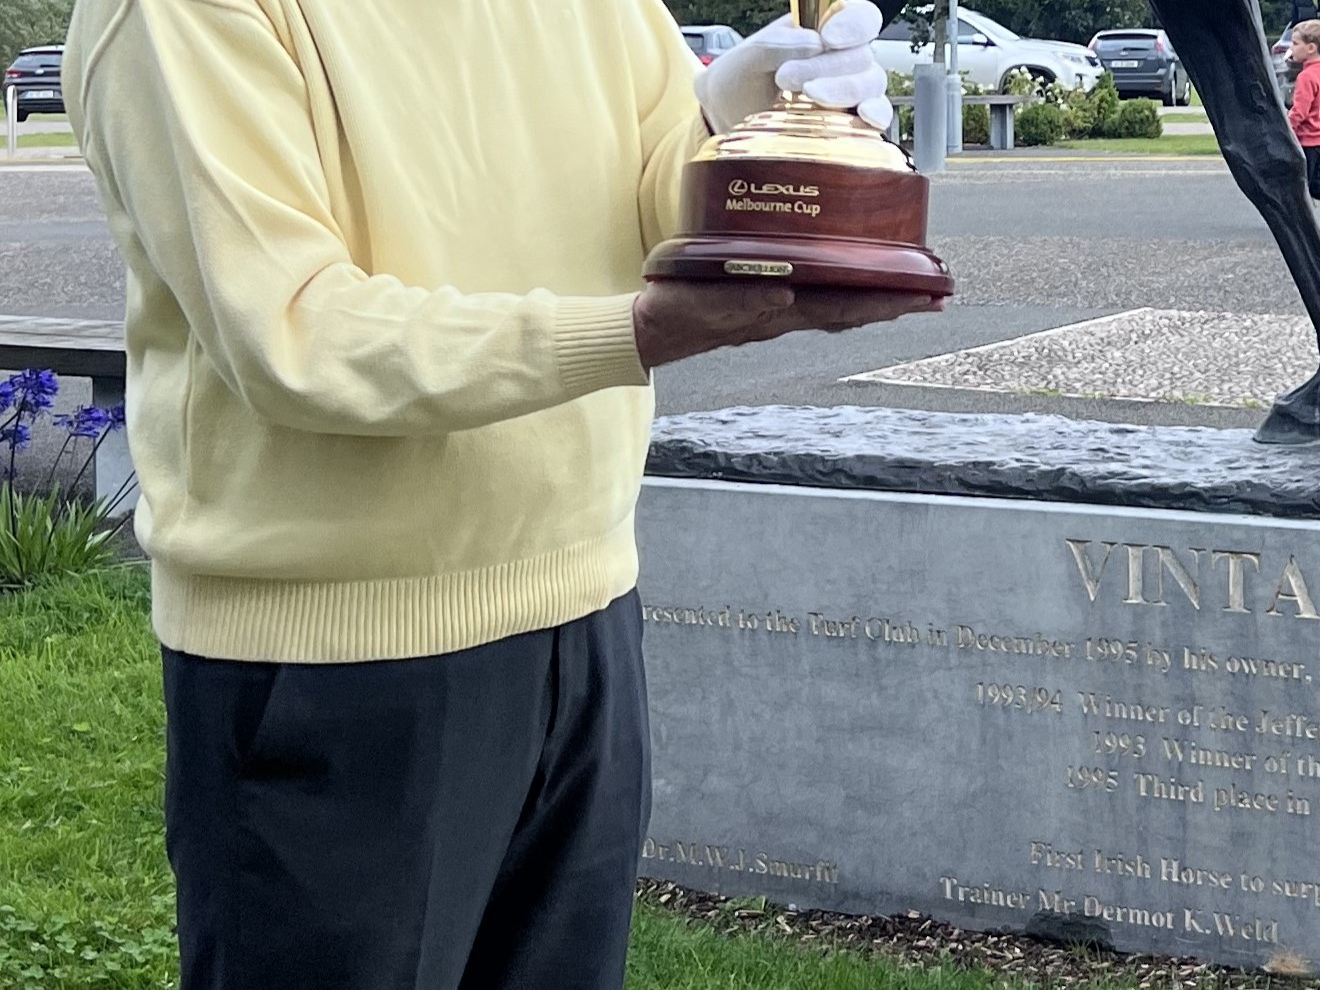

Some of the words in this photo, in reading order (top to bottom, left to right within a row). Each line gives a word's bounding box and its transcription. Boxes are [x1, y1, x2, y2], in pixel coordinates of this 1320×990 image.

[725, 197, 792, 212] Melbourne
[794, 200, 821, 218] Cup
[750, 183, 820, 196] LEXUS
[641, 604, 731, 628] resented
[738, 609, 759, 630] to
[766, 609, 800, 634] the
[807, 611, 859, 639] Turf
[864, 616, 920, 645] Club
[927, 622, 947, 647] in
[955, 624, 1075, 659] December
[1085, 636, 1138, 666] 1995
[1145, 639, 1173, 673] by
[1183, 646, 1219, 674] his
[1225, 655, 1313, 684] owner,
[975, 680, 1064, 714] 1993/94
[1077, 690, 1171, 724] Winner
[1177, 703, 1203, 728] of
[1208, 706, 1249, 733] the
[1092, 729, 1147, 759] 1993
[1161, 736, 1258, 772] Winner
[1264, 750, 1291, 775] of
[1066, 764, 1119, 793] 1995
[1133, 771, 1205, 803] Third
[1212, 783, 1280, 813] place
[1286, 789, 1311, 817] in
[1029, 839, 1084, 871] First
[1093, 848, 1151, 879] Irish
[1159, 856, 1233, 890] Horse
[1240, 870, 1266, 894] to
[939, 875, 1031, 911] Trainer
[1038, 887, 1076, 916] Mr
[1082, 894, 1175, 930] Dermot
